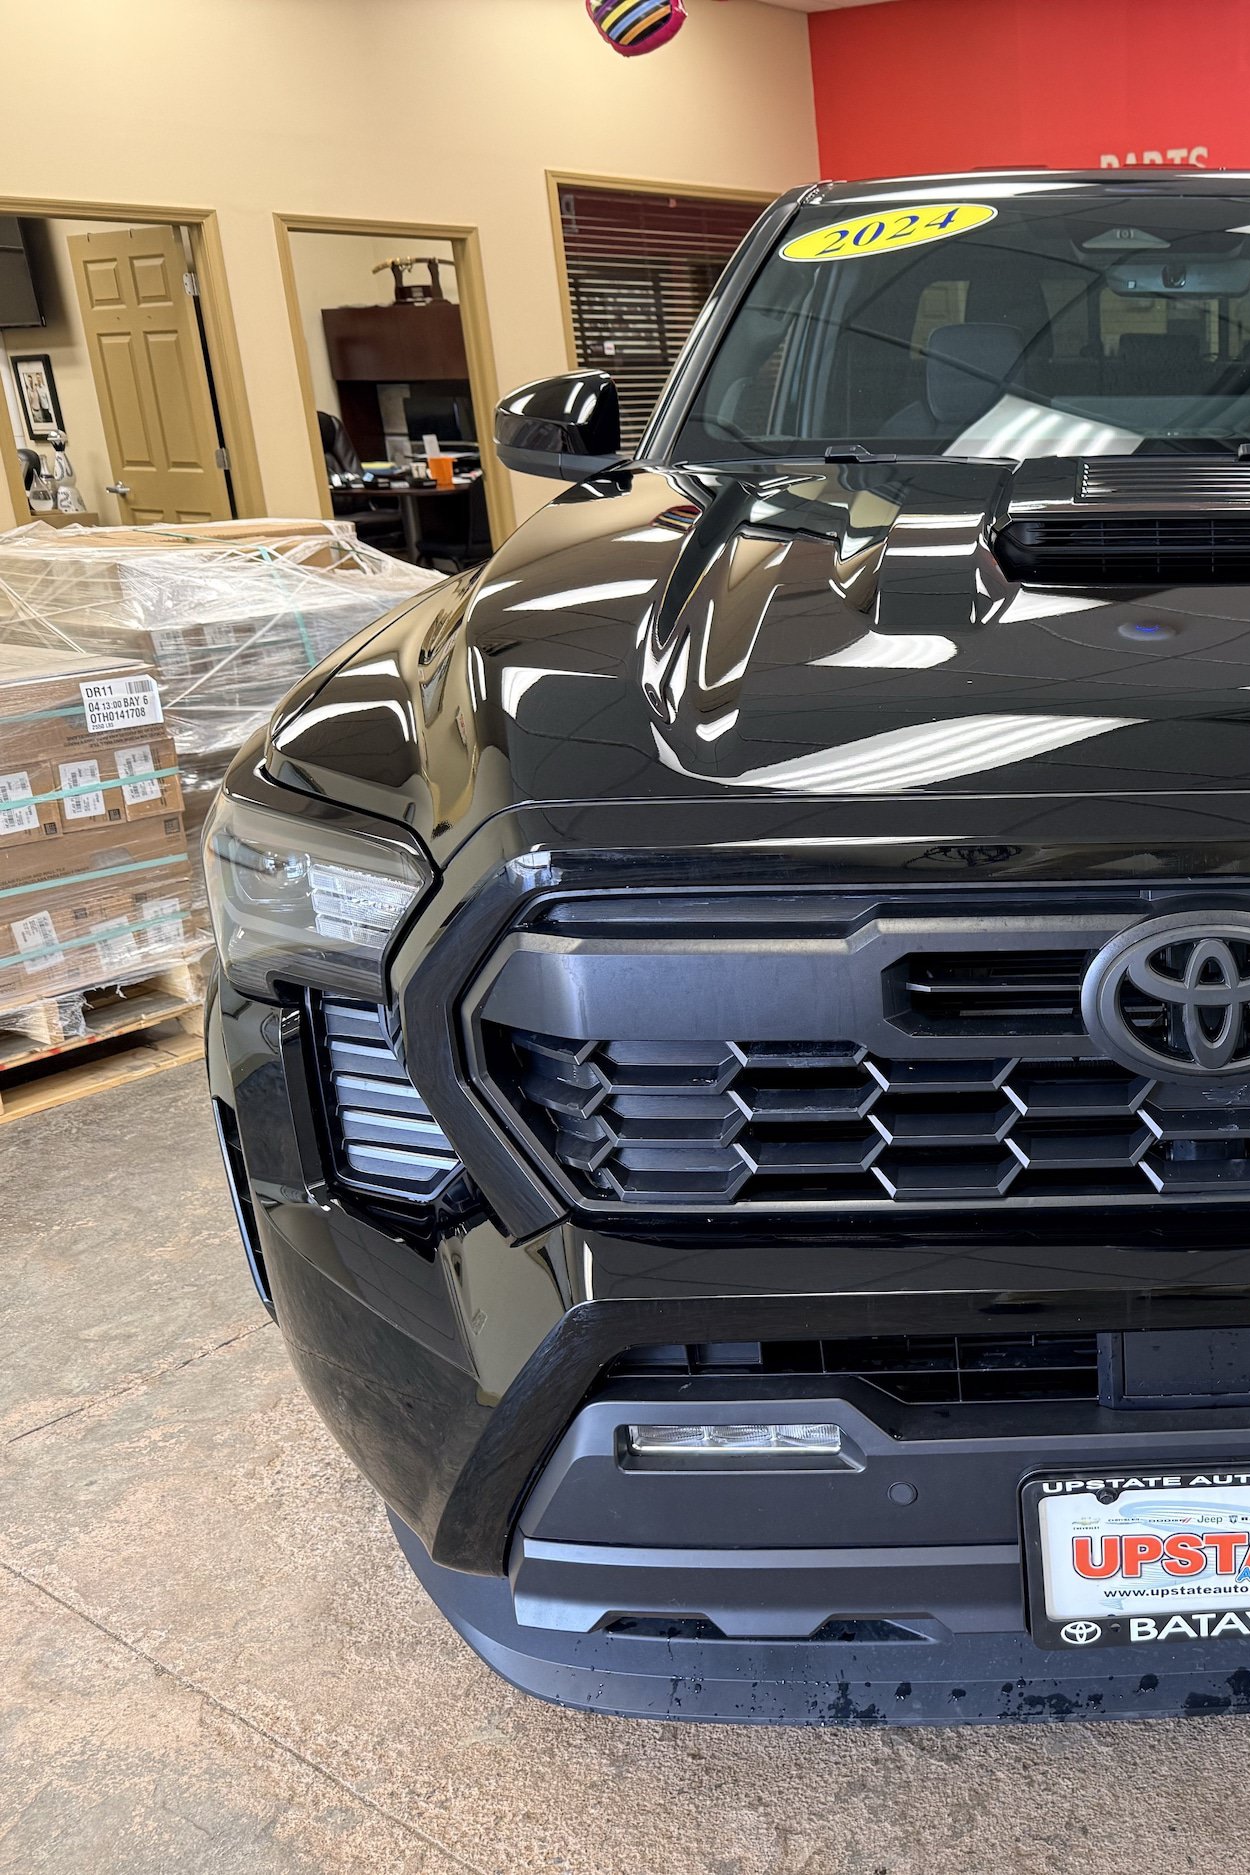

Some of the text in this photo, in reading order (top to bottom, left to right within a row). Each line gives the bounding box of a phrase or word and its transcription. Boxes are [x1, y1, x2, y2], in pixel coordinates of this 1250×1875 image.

[815, 207, 960, 256] 2024
[85, 685, 114, 698] DR11
[88, 695, 149, 713] 04 13:00 BAY 6
[1042, 1476, 1181, 1494] UPSTATE
[1196, 1514, 1223, 1525] Jeep
